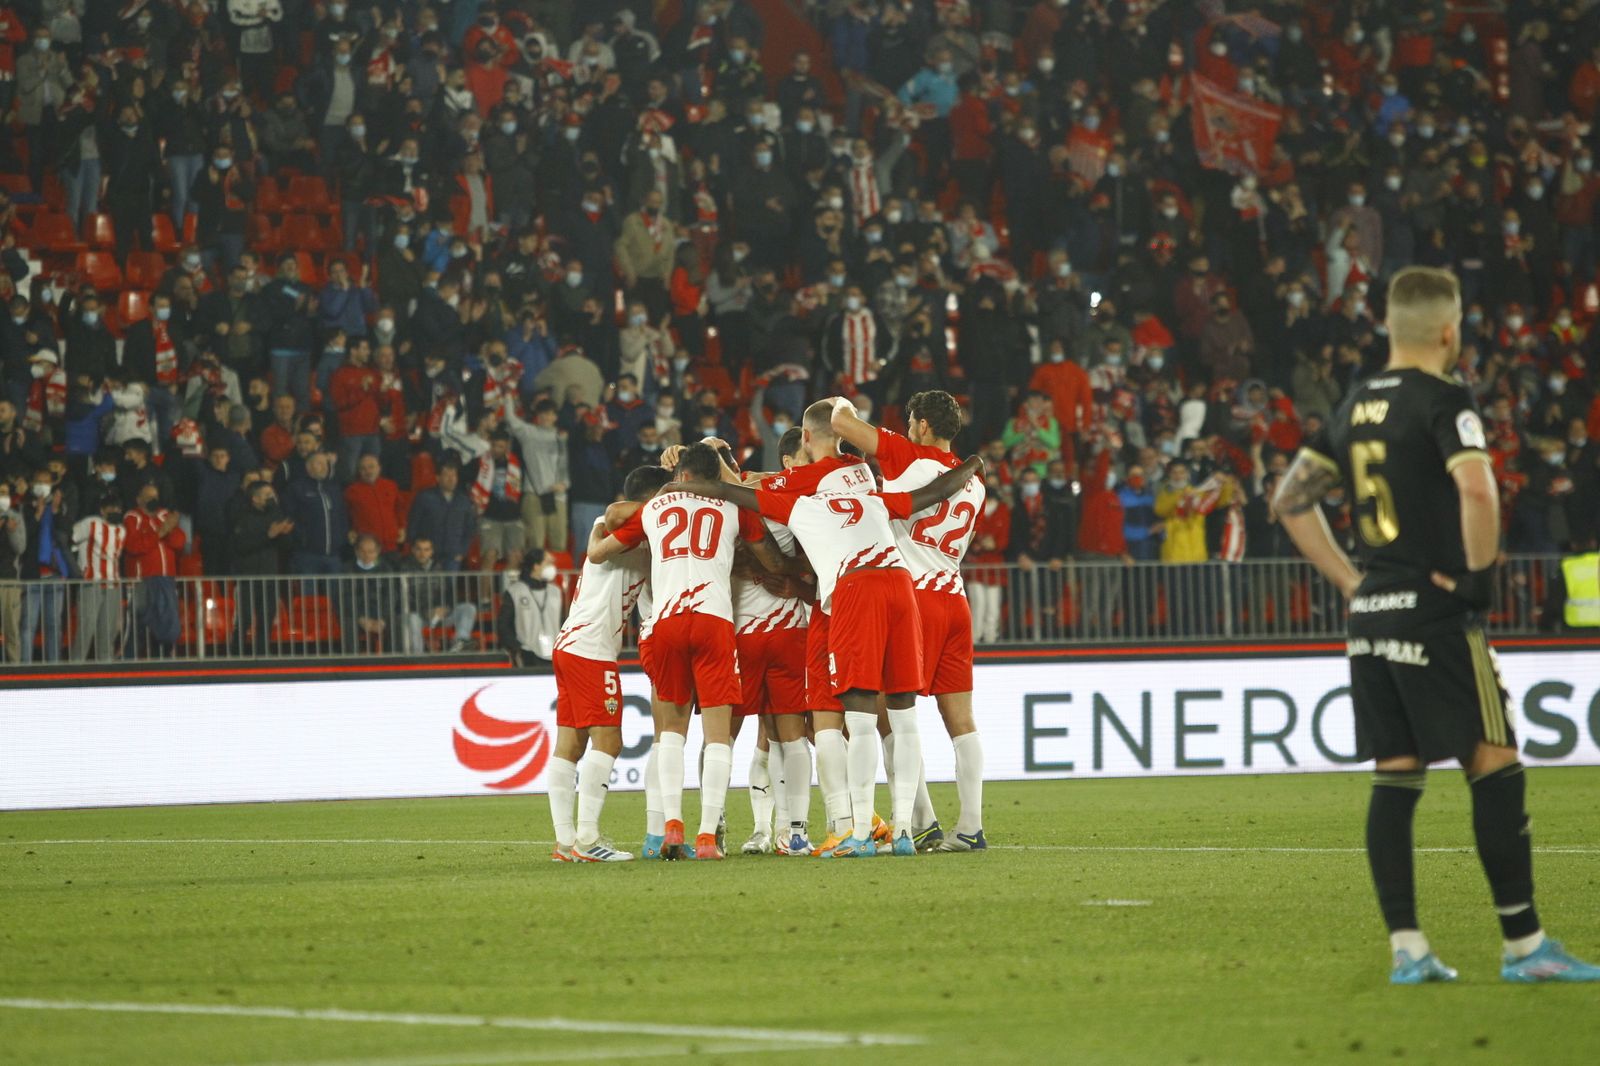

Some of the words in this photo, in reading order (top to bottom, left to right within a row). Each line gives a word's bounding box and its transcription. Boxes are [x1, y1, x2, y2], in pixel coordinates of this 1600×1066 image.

[826, 497, 864, 529] 9
[1350, 439, 1399, 547] 5
[656, 506, 724, 563] 20
[910, 499, 976, 560] 22
[604, 670, 618, 696] 5
[1023, 689, 1354, 773] ENER
[1521, 680, 1600, 760] S
